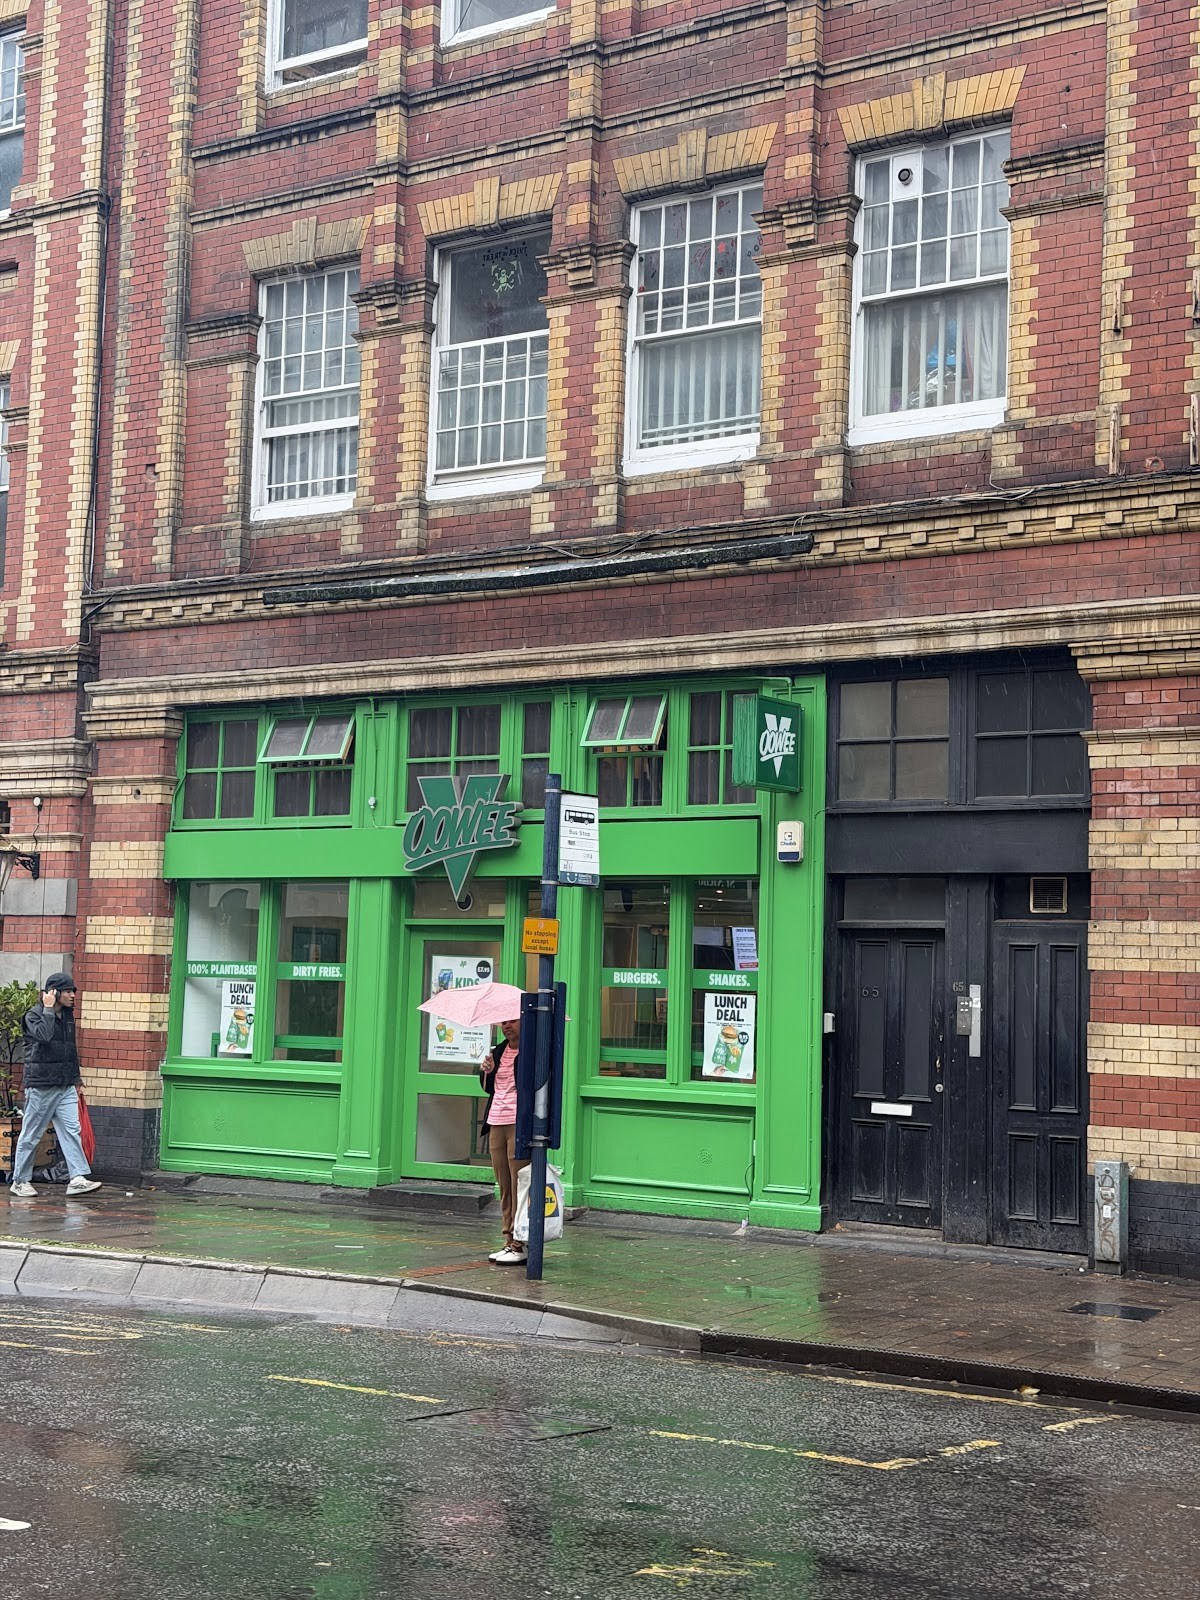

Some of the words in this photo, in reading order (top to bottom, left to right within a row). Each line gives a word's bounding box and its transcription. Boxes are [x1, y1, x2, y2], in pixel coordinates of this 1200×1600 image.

[759, 729, 796, 756] OOWEE
[403, 798, 523, 860] OOWEE
[534, 930, 557, 938] stopping
[188, 964, 208, 974] 100%
[210, 964, 257, 976] PLANTBASED
[292, 965, 317, 977] DIRTY
[318, 966, 343, 978] FRIES.
[455, 976, 480, 988] KIDS
[613, 971, 661, 985] BURGERS.
[708, 973, 751, 987] SHAKES.
[230, 983, 254, 994] LUNCH
[862, 985, 879, 997] 65
[953, 982, 964, 991] 65
[231, 995, 251, 1005] DEAL.
[714, 996, 747, 1009] LUNCH
[716, 1008, 745, 1022] DEAL.
